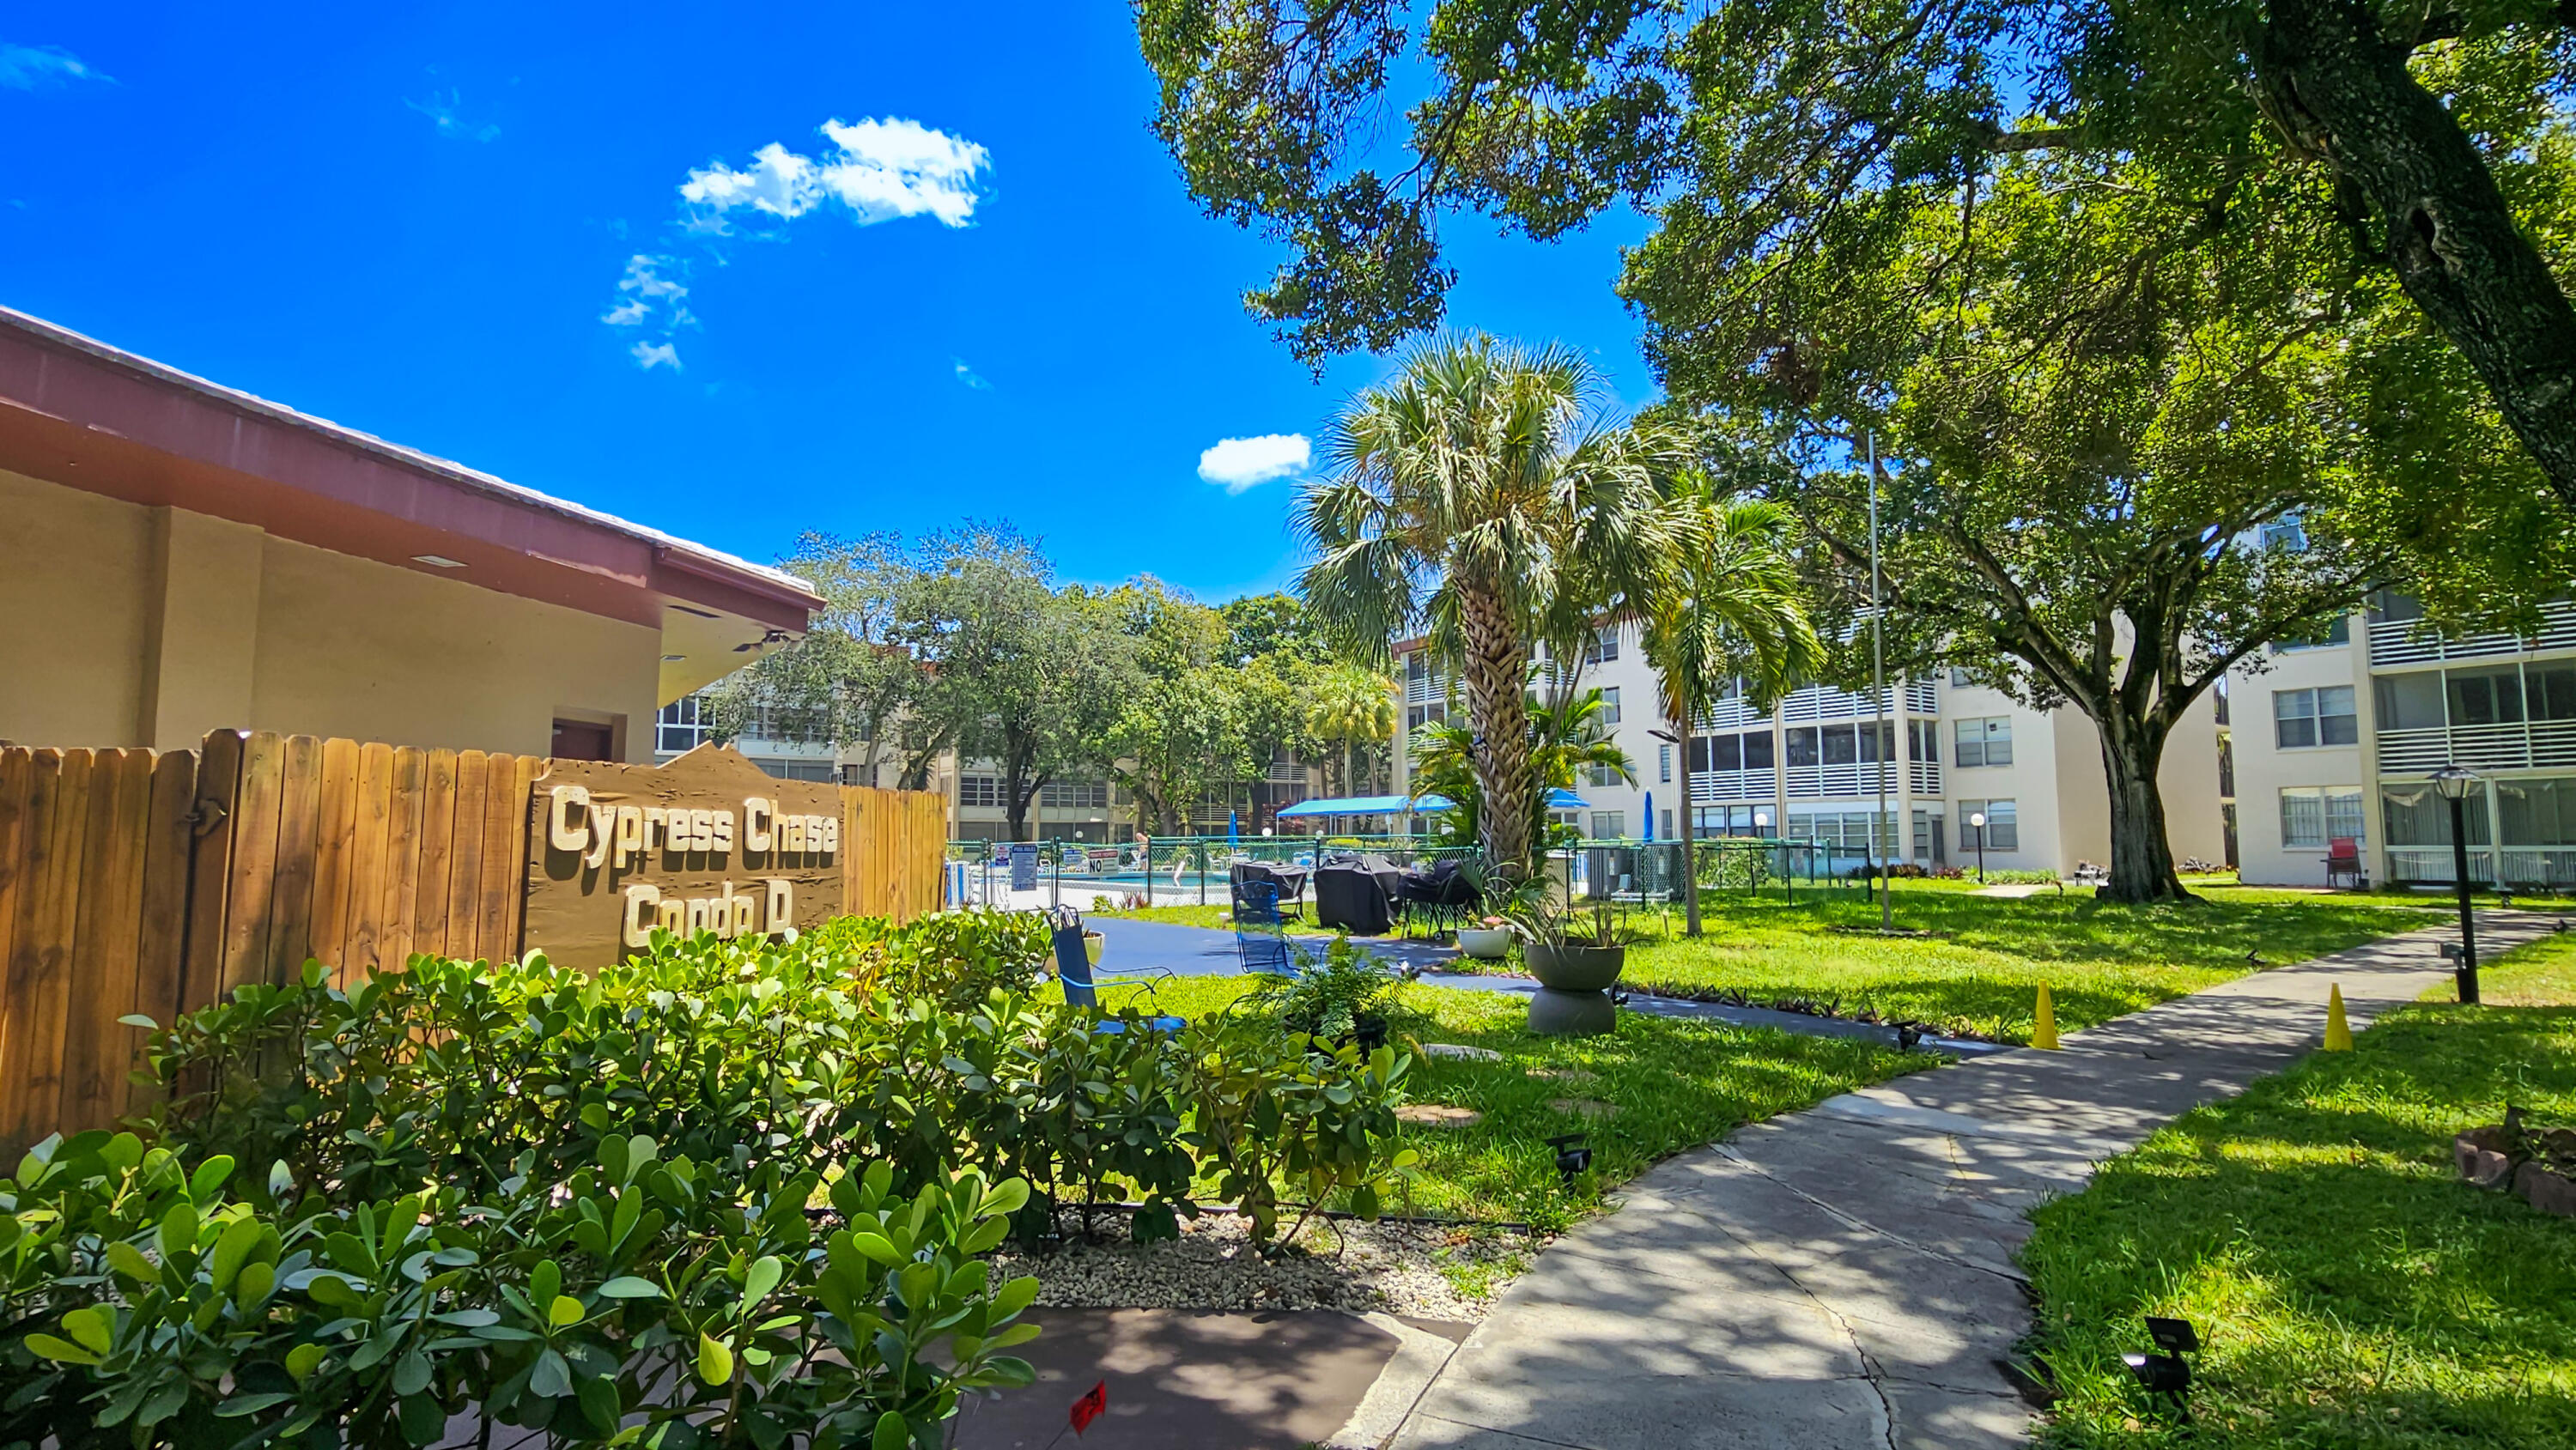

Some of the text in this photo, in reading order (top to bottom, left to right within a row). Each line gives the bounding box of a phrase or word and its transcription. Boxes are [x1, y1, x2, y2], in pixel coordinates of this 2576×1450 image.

[551, 786, 838, 869] Cypress Chase
[1090, 859, 1102, 872] NO
[623, 880, 793, 949] Condo D
